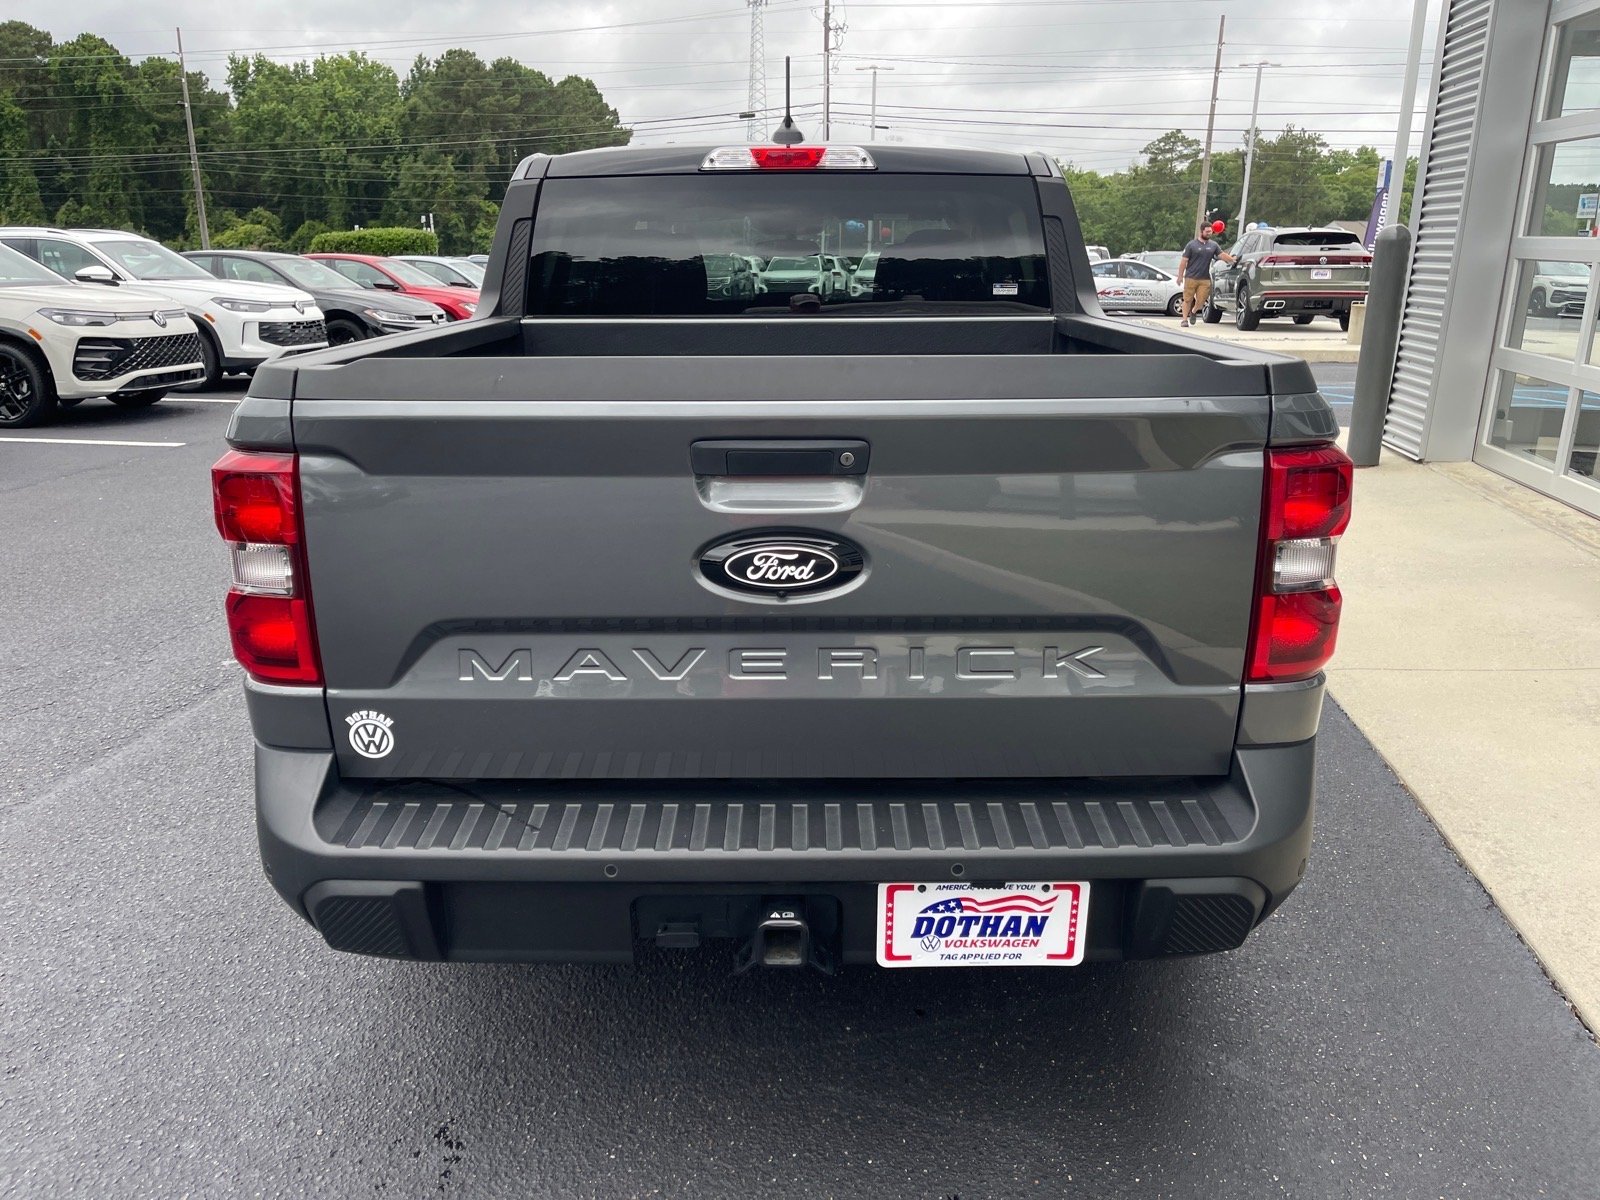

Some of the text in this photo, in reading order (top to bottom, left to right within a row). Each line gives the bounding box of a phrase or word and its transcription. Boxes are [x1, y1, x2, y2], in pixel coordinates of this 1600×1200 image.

[746, 552, 816, 580] Ford
[457, 646, 1107, 681] MAVERICK
[344, 710, 394, 728] DOTHAN
[910, 915, 1049, 938] DOTHAN
[944, 939, 1039, 948] VOLKSWAGEN
